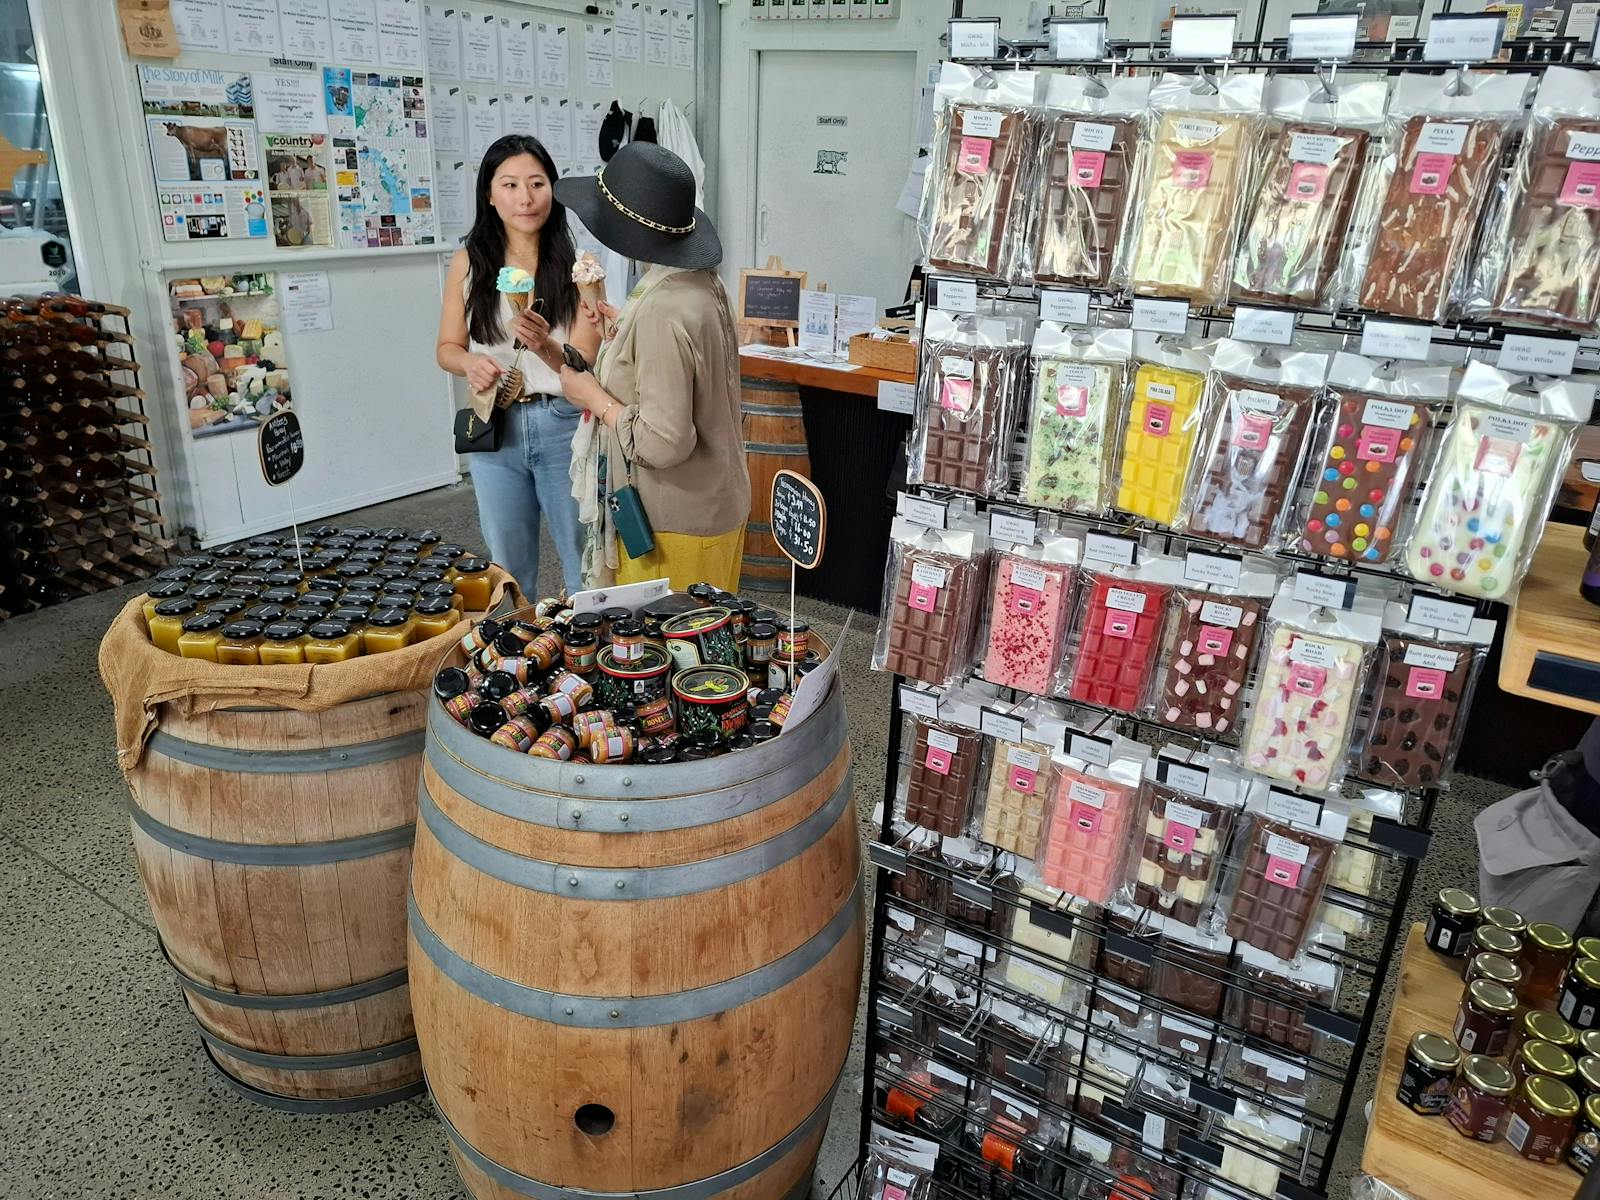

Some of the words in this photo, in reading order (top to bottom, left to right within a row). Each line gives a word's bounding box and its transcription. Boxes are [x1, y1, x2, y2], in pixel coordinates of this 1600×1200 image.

[164, 68, 187, 86] Story
[189, 69, 200, 83] of
[203, 70, 226, 85] Milk
[273, 136, 314, 148] country
[1534, 356, 1553, 364] White
[1371, 404, 1393, 412] POLKA
[1488, 415, 1512, 424] POLKA
[1304, 642, 1325, 650] ROCKY
[1305, 648, 1323, 656] ROAD
[1436, 654, 1456, 662] Raisin
[647, 715, 665, 728] HONEY
